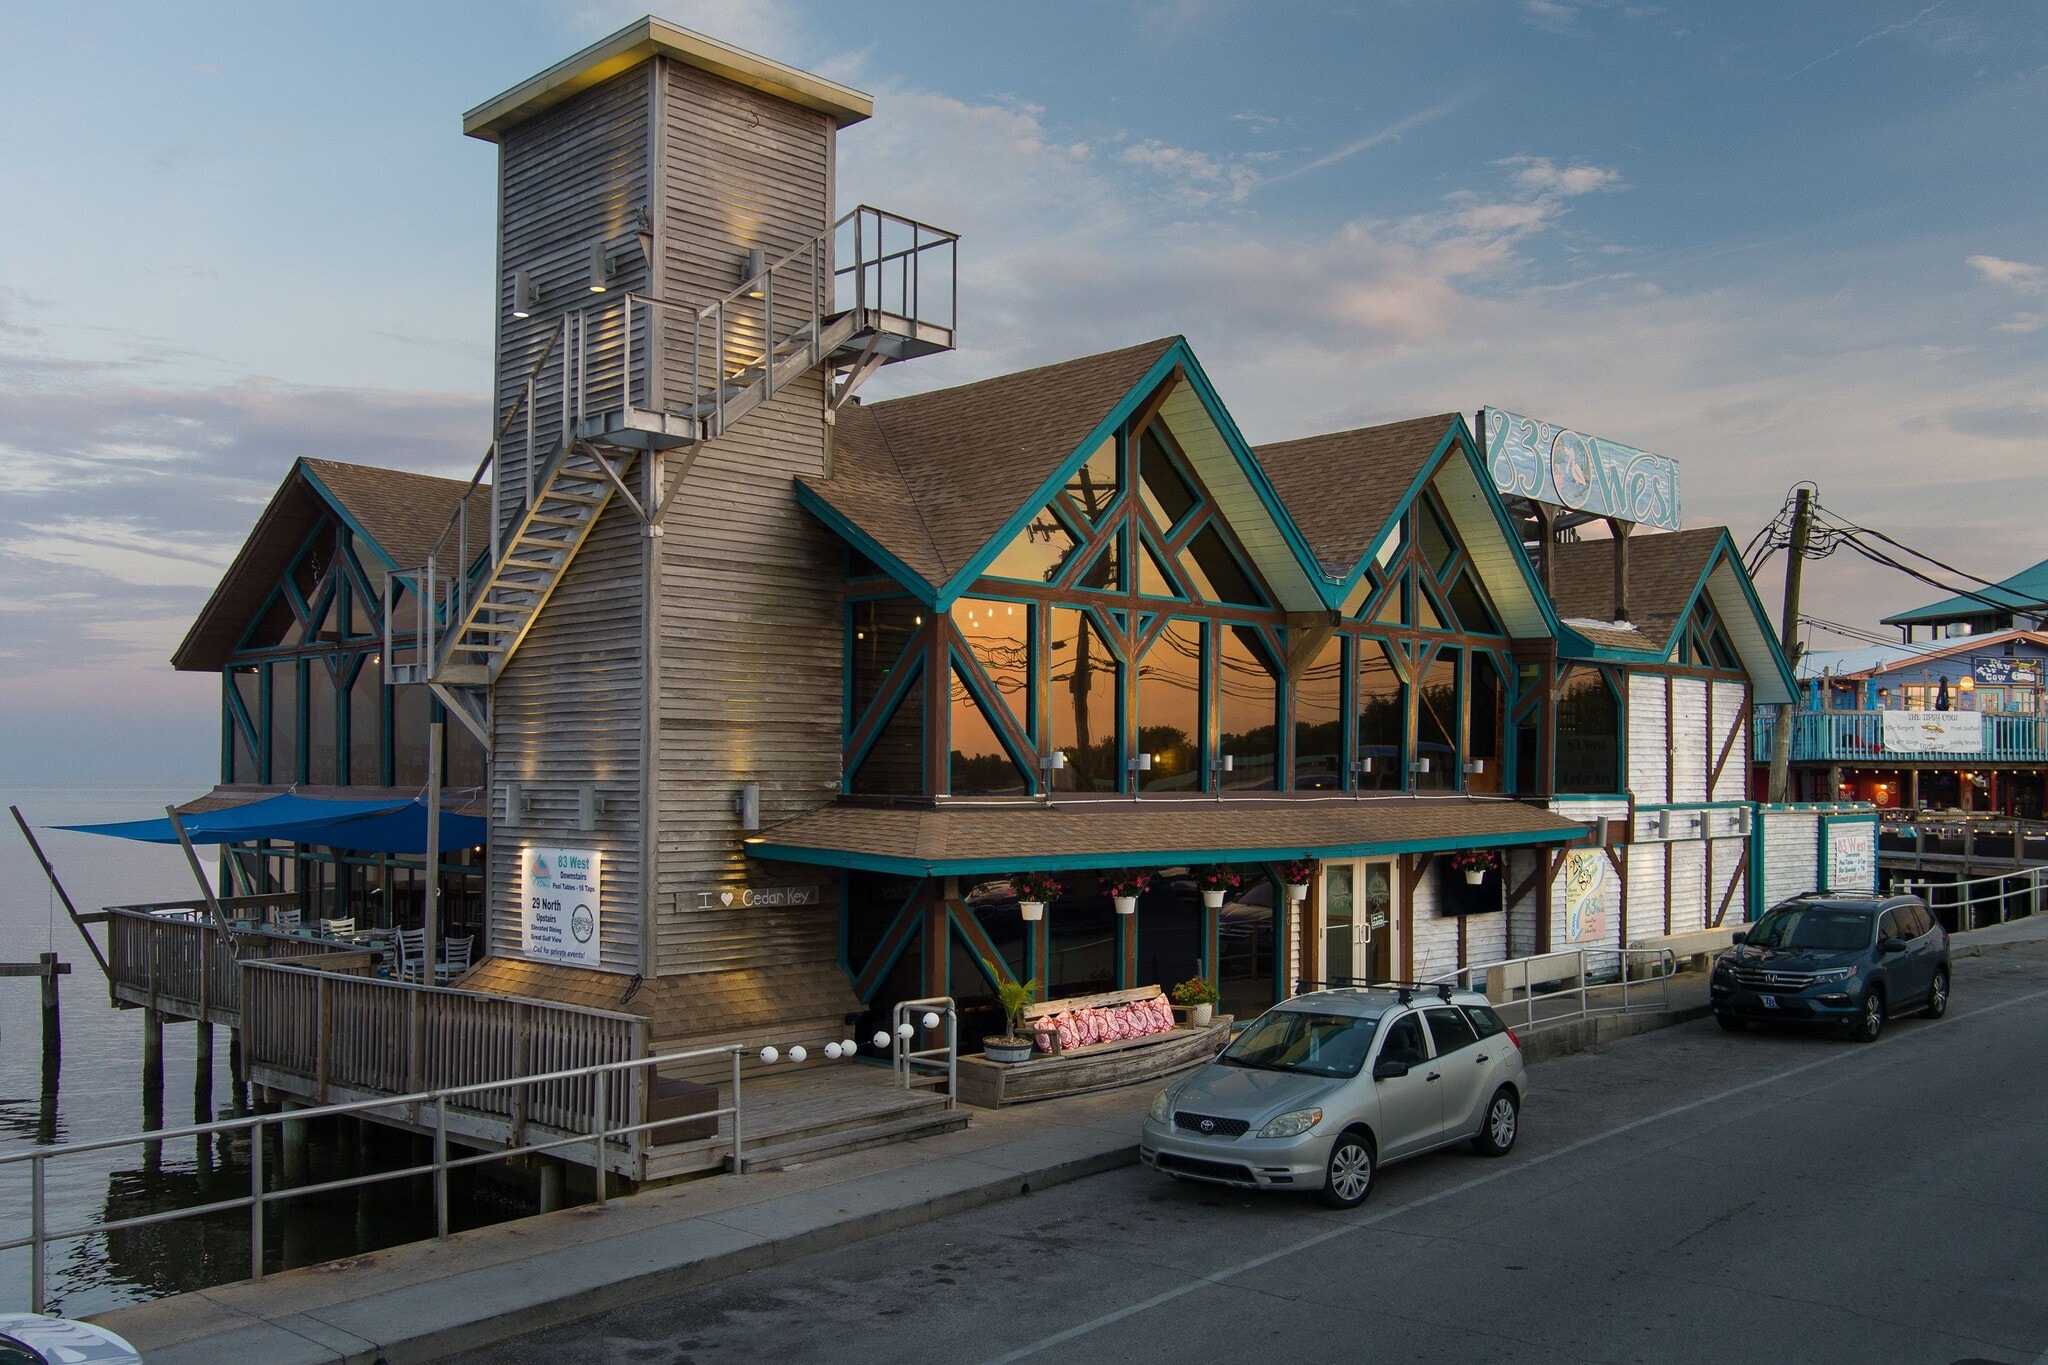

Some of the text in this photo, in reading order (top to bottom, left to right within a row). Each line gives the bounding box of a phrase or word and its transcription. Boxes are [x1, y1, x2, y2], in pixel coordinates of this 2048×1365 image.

[1587, 436, 1680, 531] West
[1838, 838, 1866, 854] 83 West
[558, 855, 590, 870] 83 West
[560, 871, 587, 881] Downstairs
[562, 883, 576, 891] Tables
[585, 884, 595, 893] Taps
[532, 897, 561, 911] 29 North
[697, 887, 810, 909] I Cedar Key
[536, 913, 557, 923] Upstairs
[531, 924, 549, 932] Elevated
[549, 925, 562, 935] Dining
[530, 933, 542, 941] Great
[552, 935, 562, 944] View
[533, 945, 543, 954] Call
[550, 947, 567, 957] private
[567, 950, 585, 960] events!
